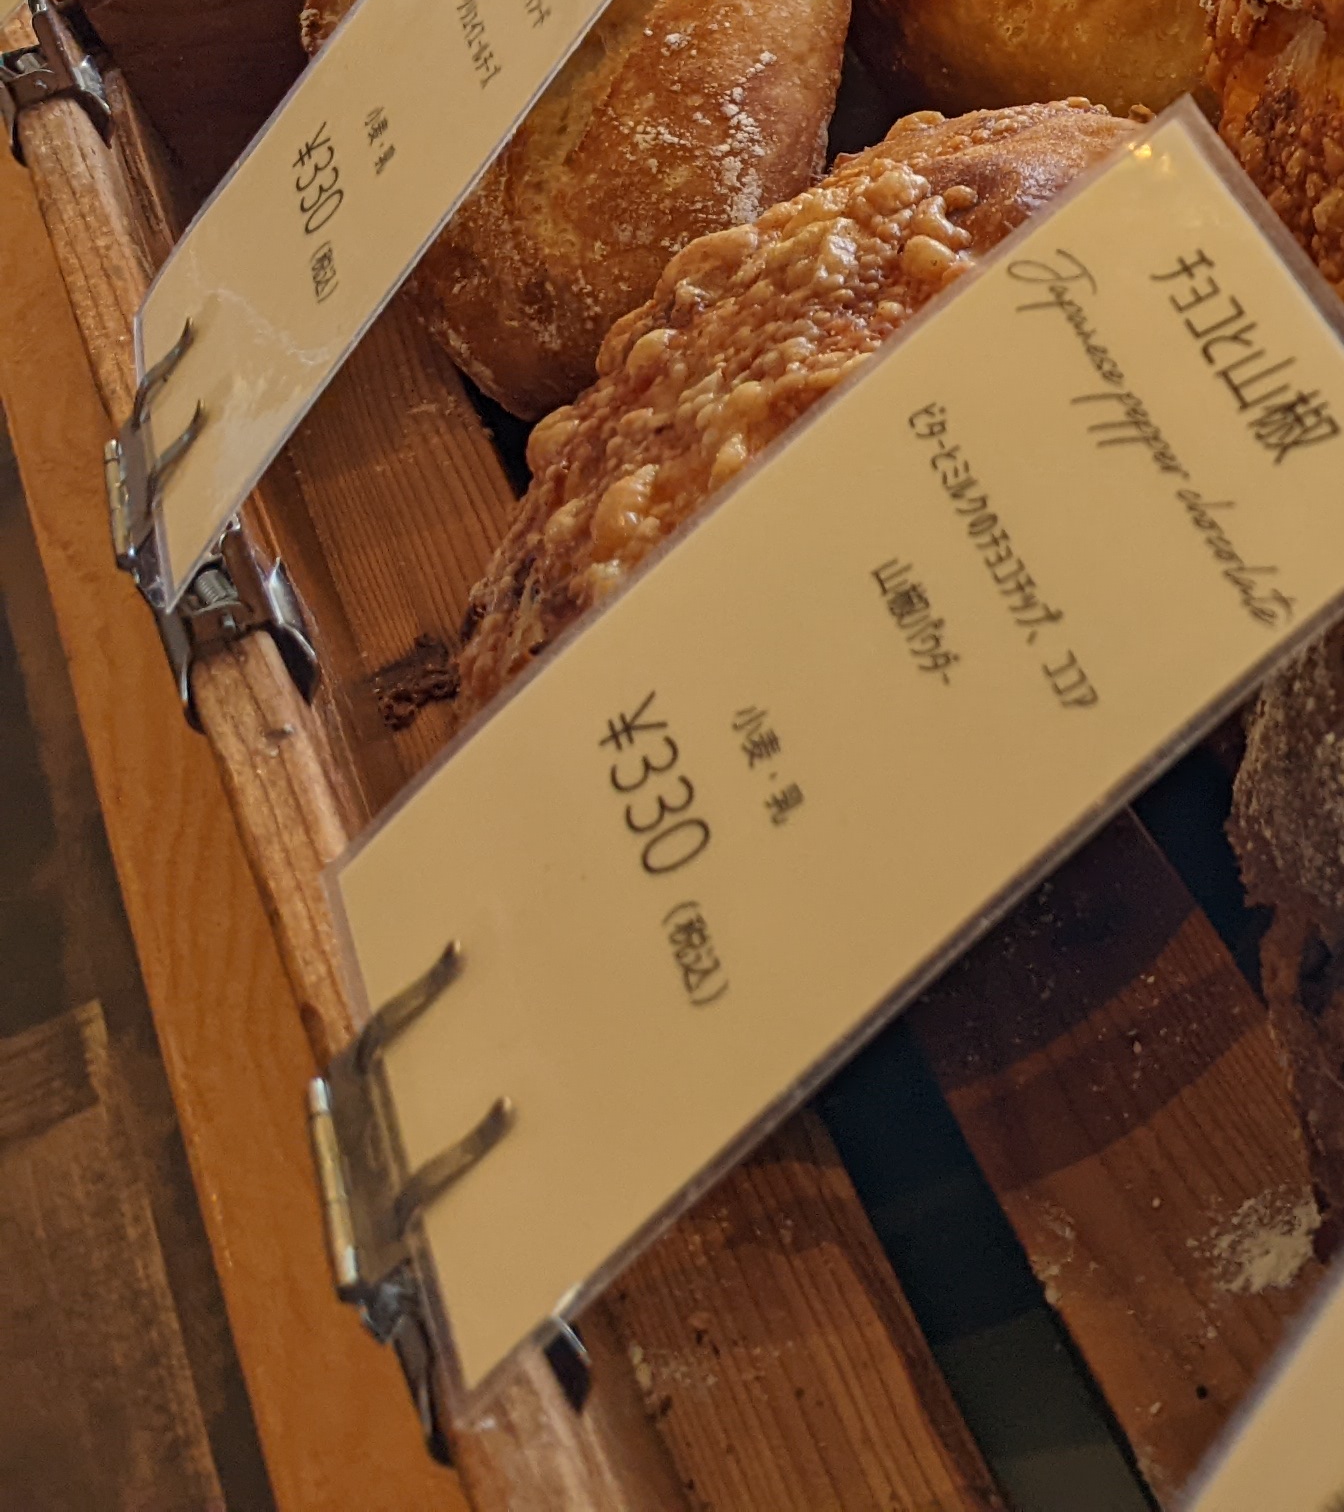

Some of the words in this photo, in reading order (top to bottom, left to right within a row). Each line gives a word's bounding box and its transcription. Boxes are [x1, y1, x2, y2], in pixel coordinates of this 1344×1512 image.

[292, 121, 344, 235] ¥330
[310, 240, 339, 305] (税込)
[1150, 247, 1341, 465] チョコと山椒
[1006, 248, 1124, 386] Japanese
[1072, 381, 1191, 476] pepper
[1177, 485, 1295, 628] chocolate
[871, 560, 961, 685] 山椒パウダー
[732, 706, 804, 826] 小麦・乳
[600, 691, 711, 875] ¥330
[663, 900, 727, 1006] (税込)
